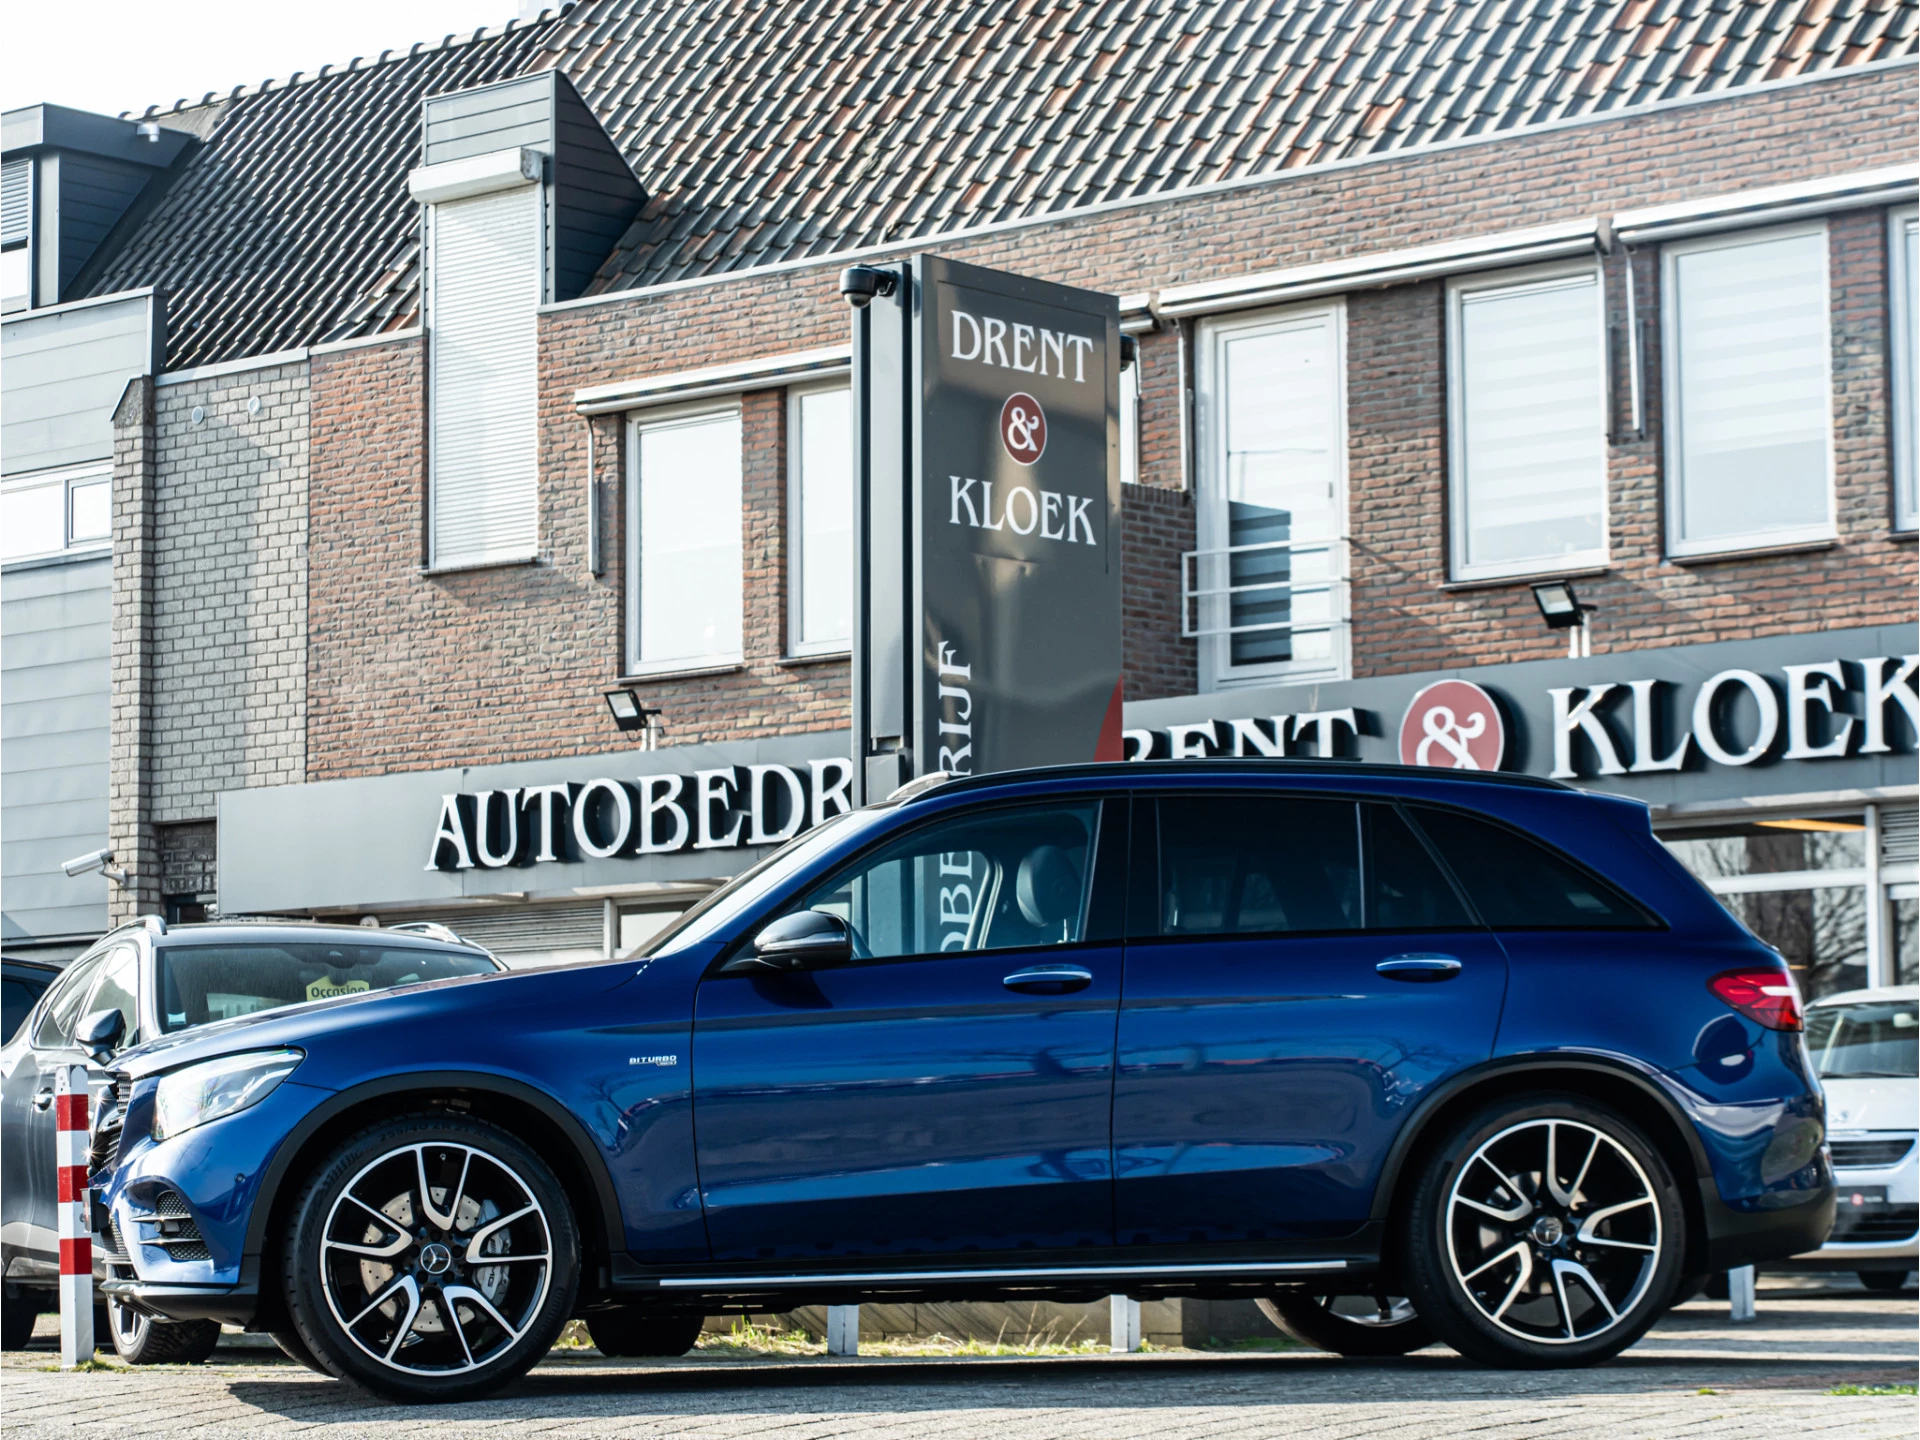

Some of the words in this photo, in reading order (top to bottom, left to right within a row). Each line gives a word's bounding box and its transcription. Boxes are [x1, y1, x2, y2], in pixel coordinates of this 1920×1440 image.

[950, 309, 1094, 383] DRENT
[1007, 406, 1039, 453] &
[949, 475, 1097, 546] KLOEK
[423, 757, 853, 871] AUTOBEDR
[1547, 653, 1920, 779] KLOEK
